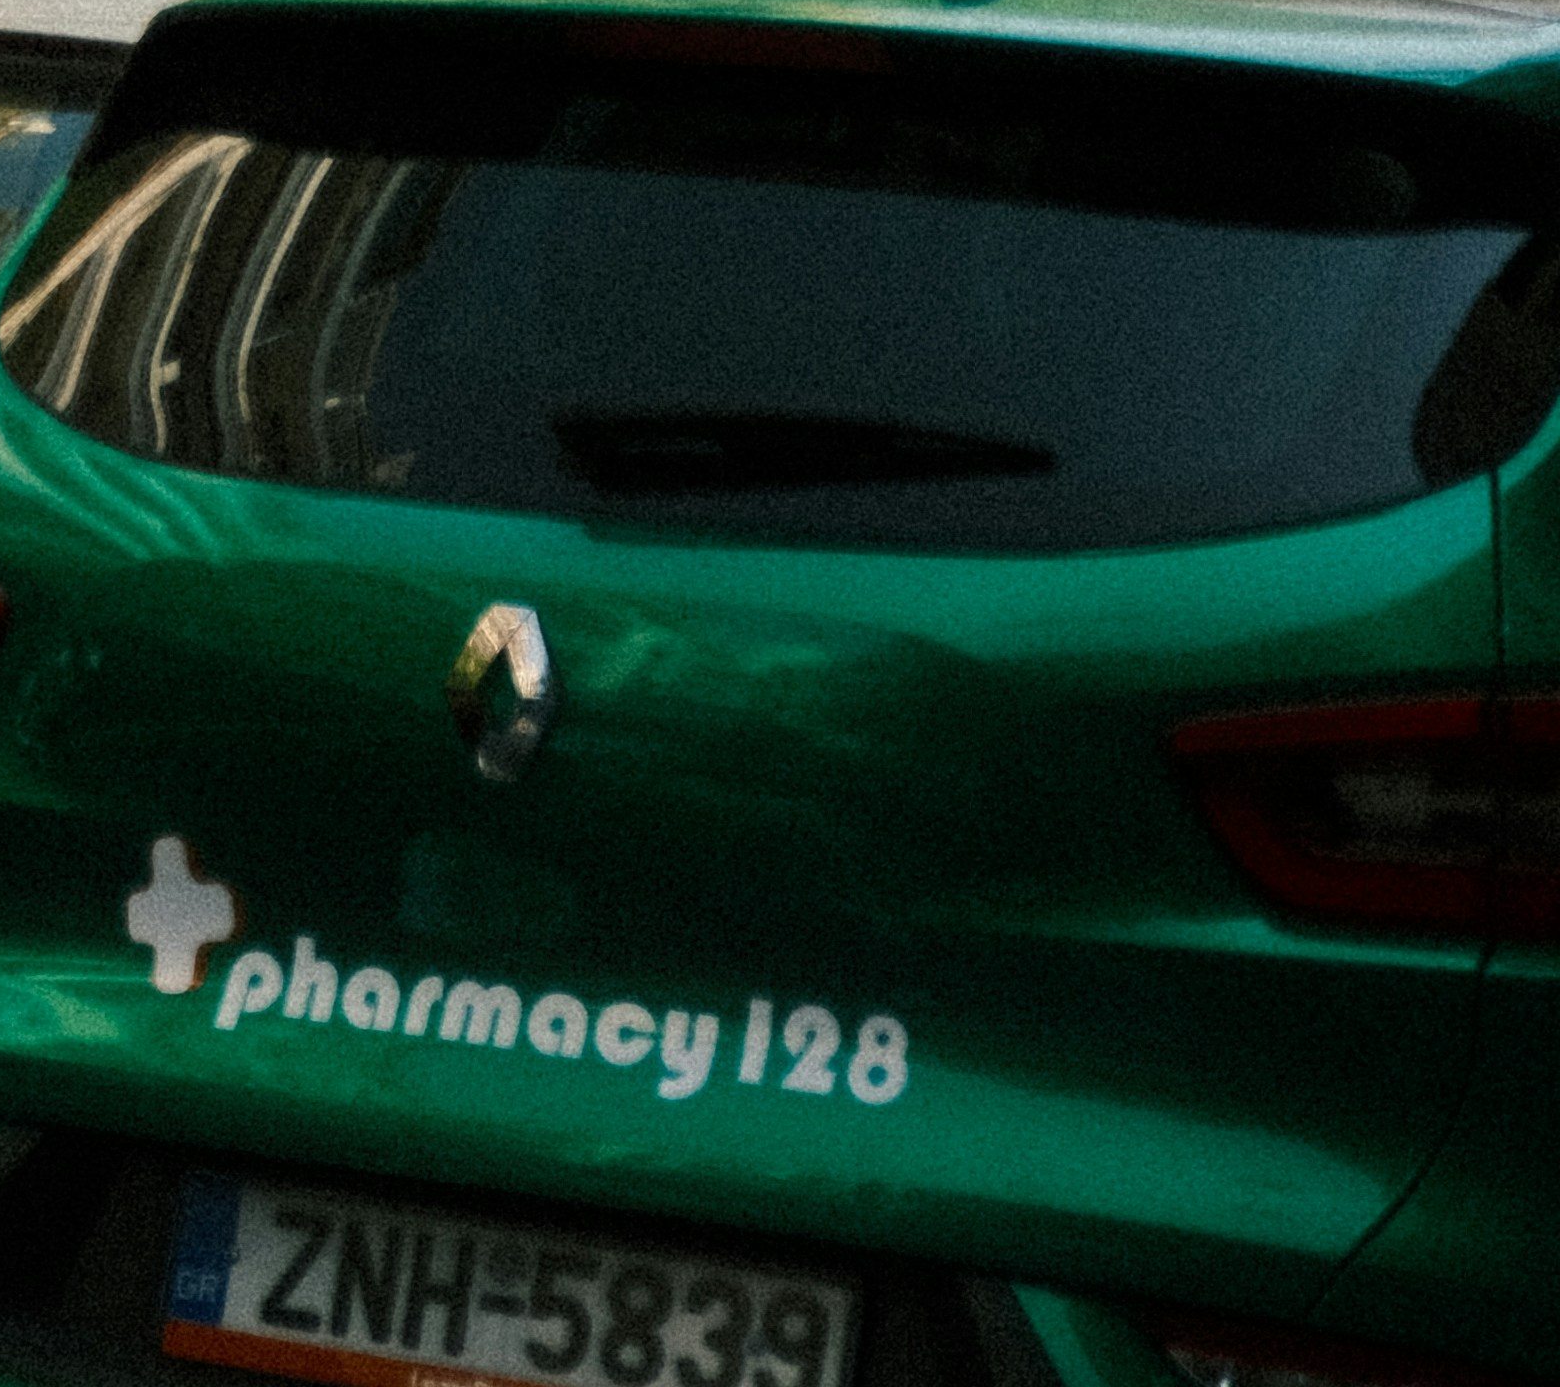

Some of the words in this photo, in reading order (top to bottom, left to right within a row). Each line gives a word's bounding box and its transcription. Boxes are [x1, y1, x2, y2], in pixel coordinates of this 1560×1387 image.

[213, 935, 719, 1100] pharmacy
[736, 998, 910, 1105] 128
[175, 1268, 219, 1304] GR
[258, 1202, 831, 1387] ZNH-5839
